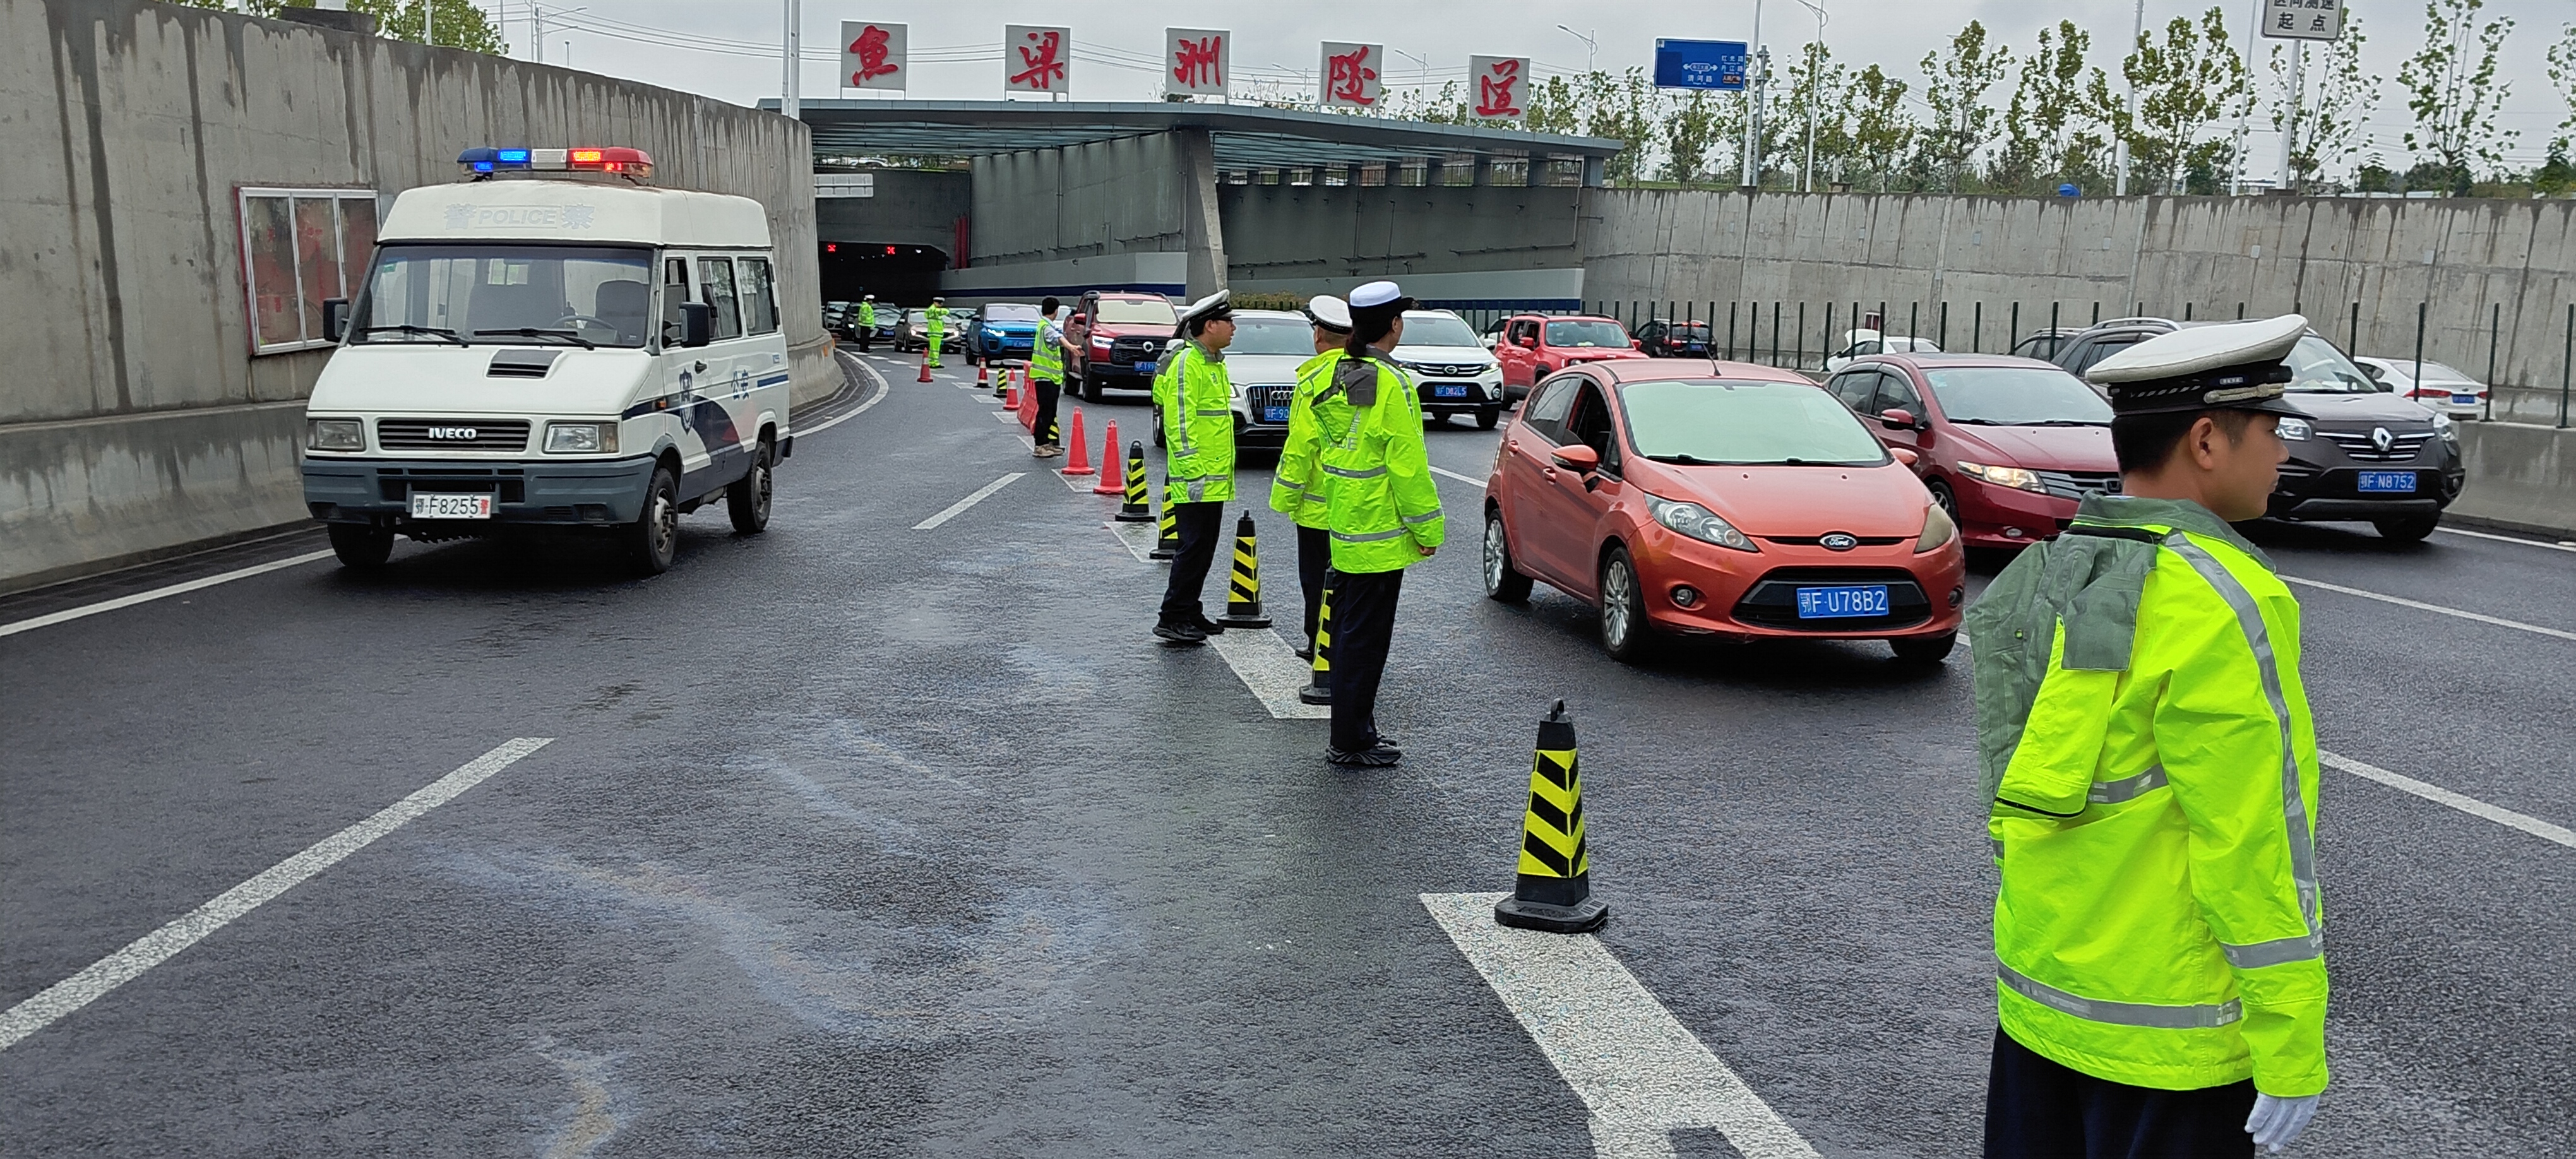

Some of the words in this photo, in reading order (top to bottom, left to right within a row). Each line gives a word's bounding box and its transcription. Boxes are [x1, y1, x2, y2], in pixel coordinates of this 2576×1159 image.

[2277, 11, 2327, 32] 起点
[444, 203, 477, 230] 警
[478, 209, 558, 225] POLICE
[561, 203, 595, 229] 察
[730, 369, 749, 400] 公安
[429, 427, 477, 439] IVECO
[1828, 537, 1850, 546] Ford
